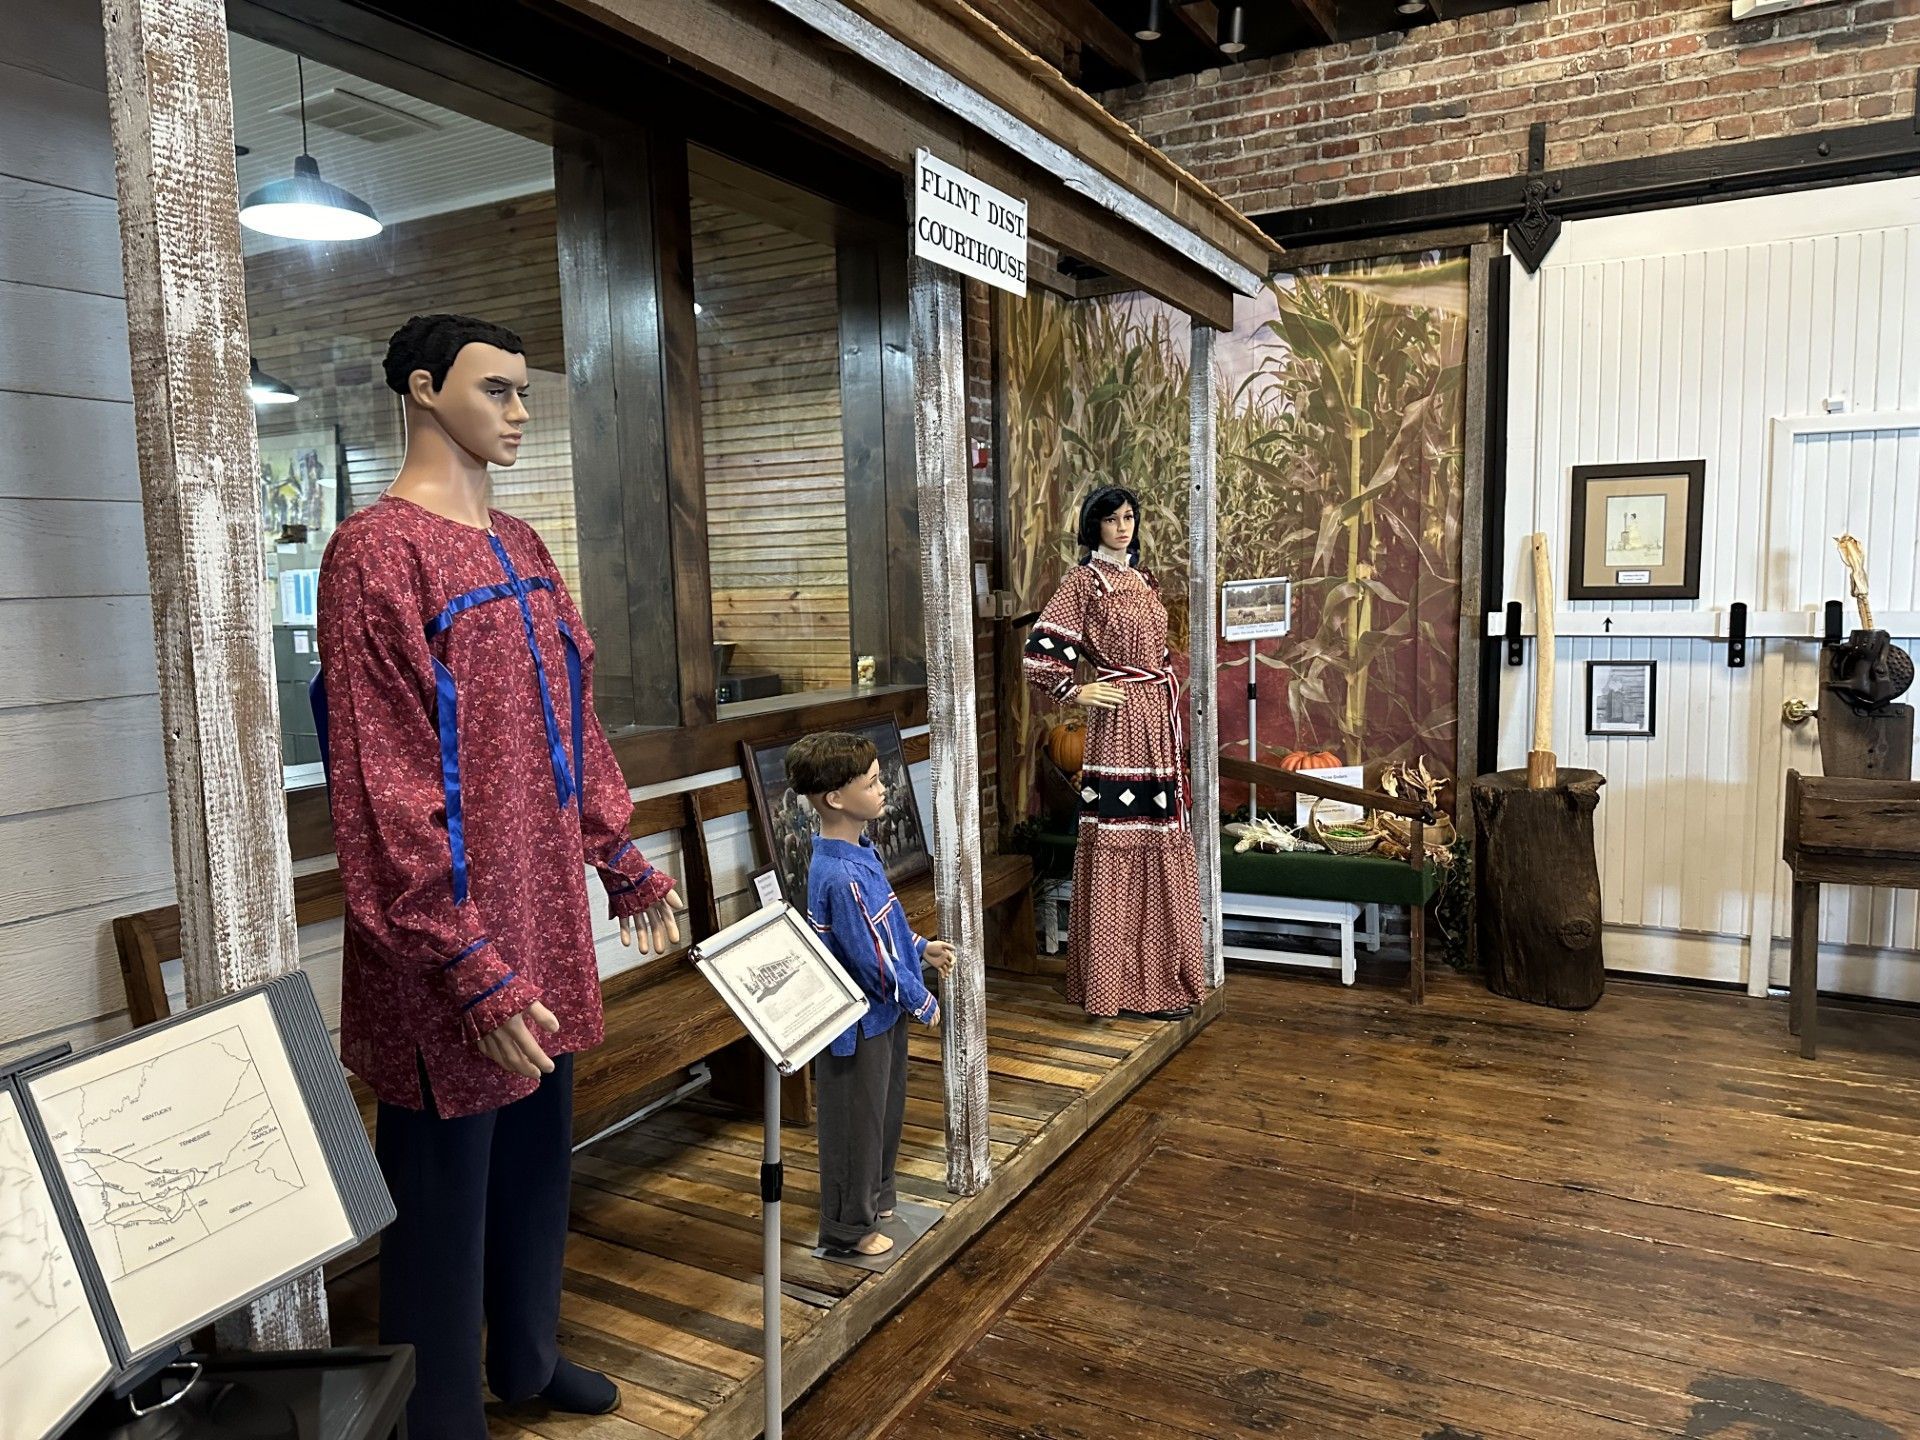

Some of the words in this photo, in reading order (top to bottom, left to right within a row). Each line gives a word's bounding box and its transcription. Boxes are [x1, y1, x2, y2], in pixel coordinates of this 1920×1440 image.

[920, 165, 981, 217] FLINT
[987, 200, 1026, 240] DIST.
[918, 216, 1026, 283] COURTHOUSE
[142, 1106, 172, 1121] KENTUCKY
[179, 1130, 211, 1147] TENNESSEE
[147, 1236, 175, 1251] ALABAMA
